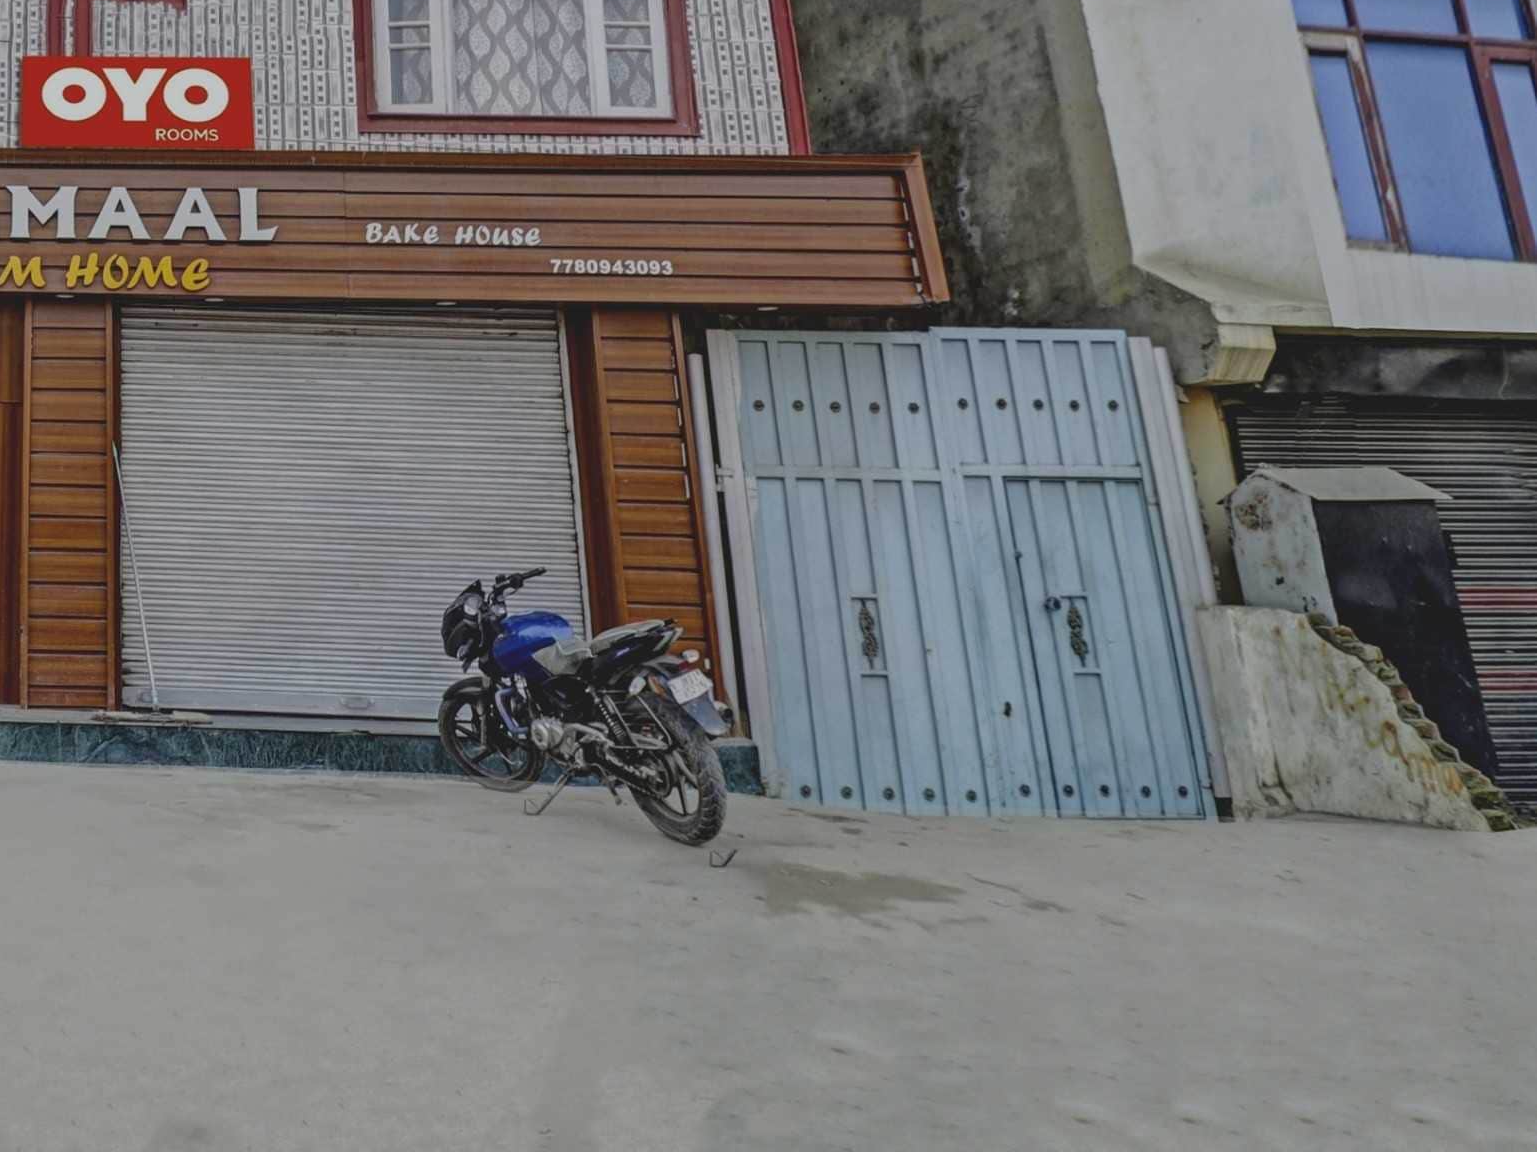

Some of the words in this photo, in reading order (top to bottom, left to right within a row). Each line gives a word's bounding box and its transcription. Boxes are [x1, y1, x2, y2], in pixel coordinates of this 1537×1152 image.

[41, 67, 230, 123] OYO
[154, 128, 219, 142] ROOMS
[365, 222, 440, 245] BAKE
[454, 226, 543, 246] HOUSE
[65, 252, 211, 291] HOME
[550, 259, 674, 276] 7780943093
